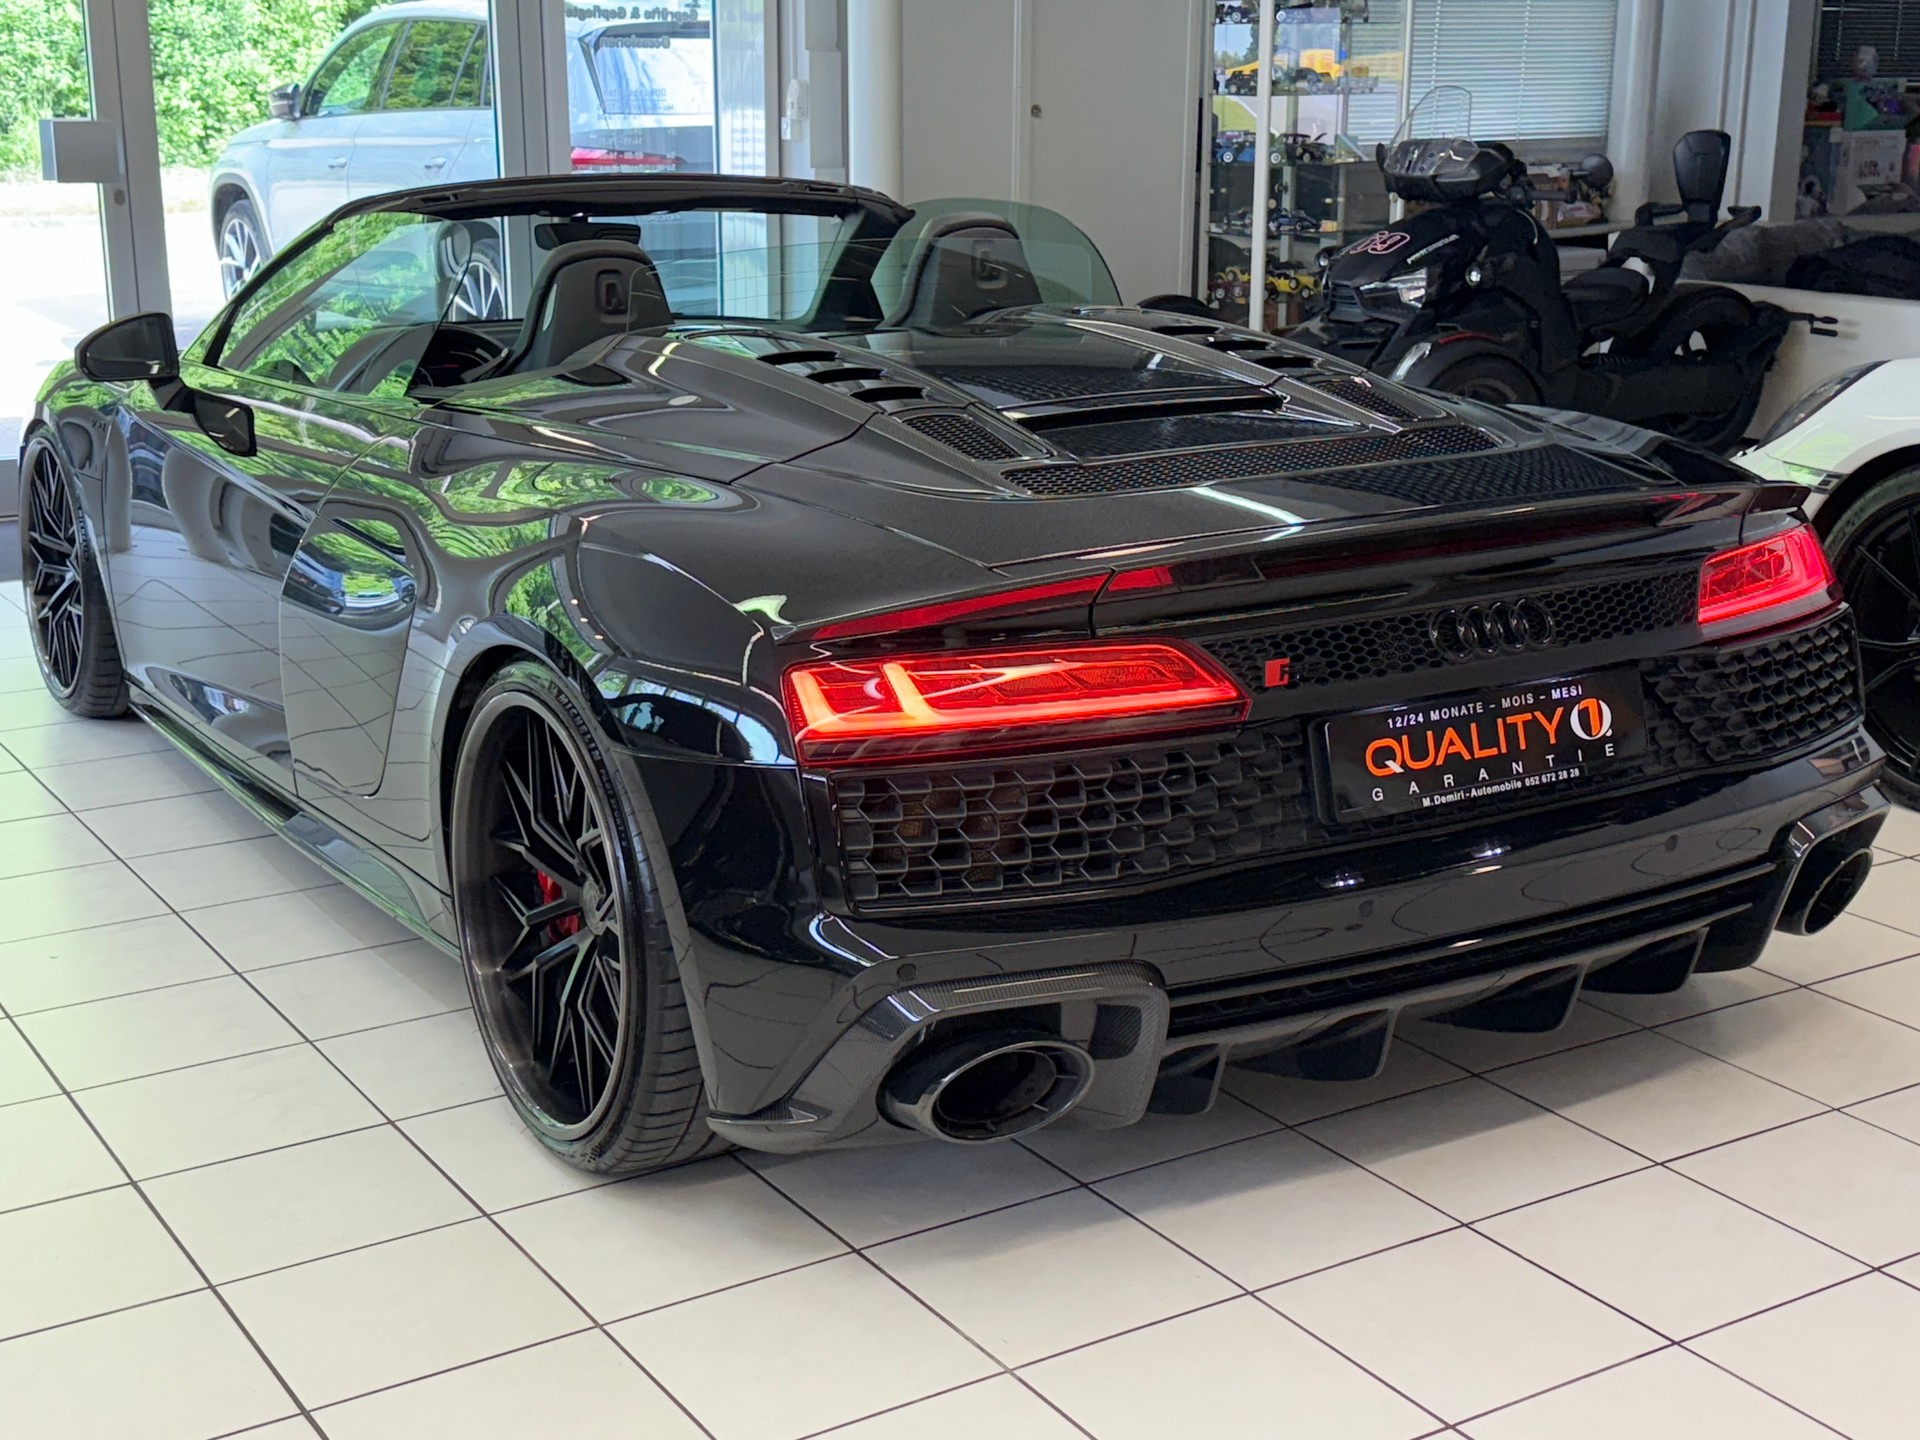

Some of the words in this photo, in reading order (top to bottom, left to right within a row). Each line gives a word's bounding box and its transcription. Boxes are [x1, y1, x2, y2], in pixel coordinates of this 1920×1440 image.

[558, 693, 602, 761] MICHELIN
[1387, 712, 1425, 729] 12/24
[1430, 702, 1484, 721] MONATE
[1501, 692, 1535, 709] MOIS
[1551, 684, 1584, 700] MESI
[1365, 706, 1564, 777] QUALITY
[1524, 776, 1540, 787] 052
